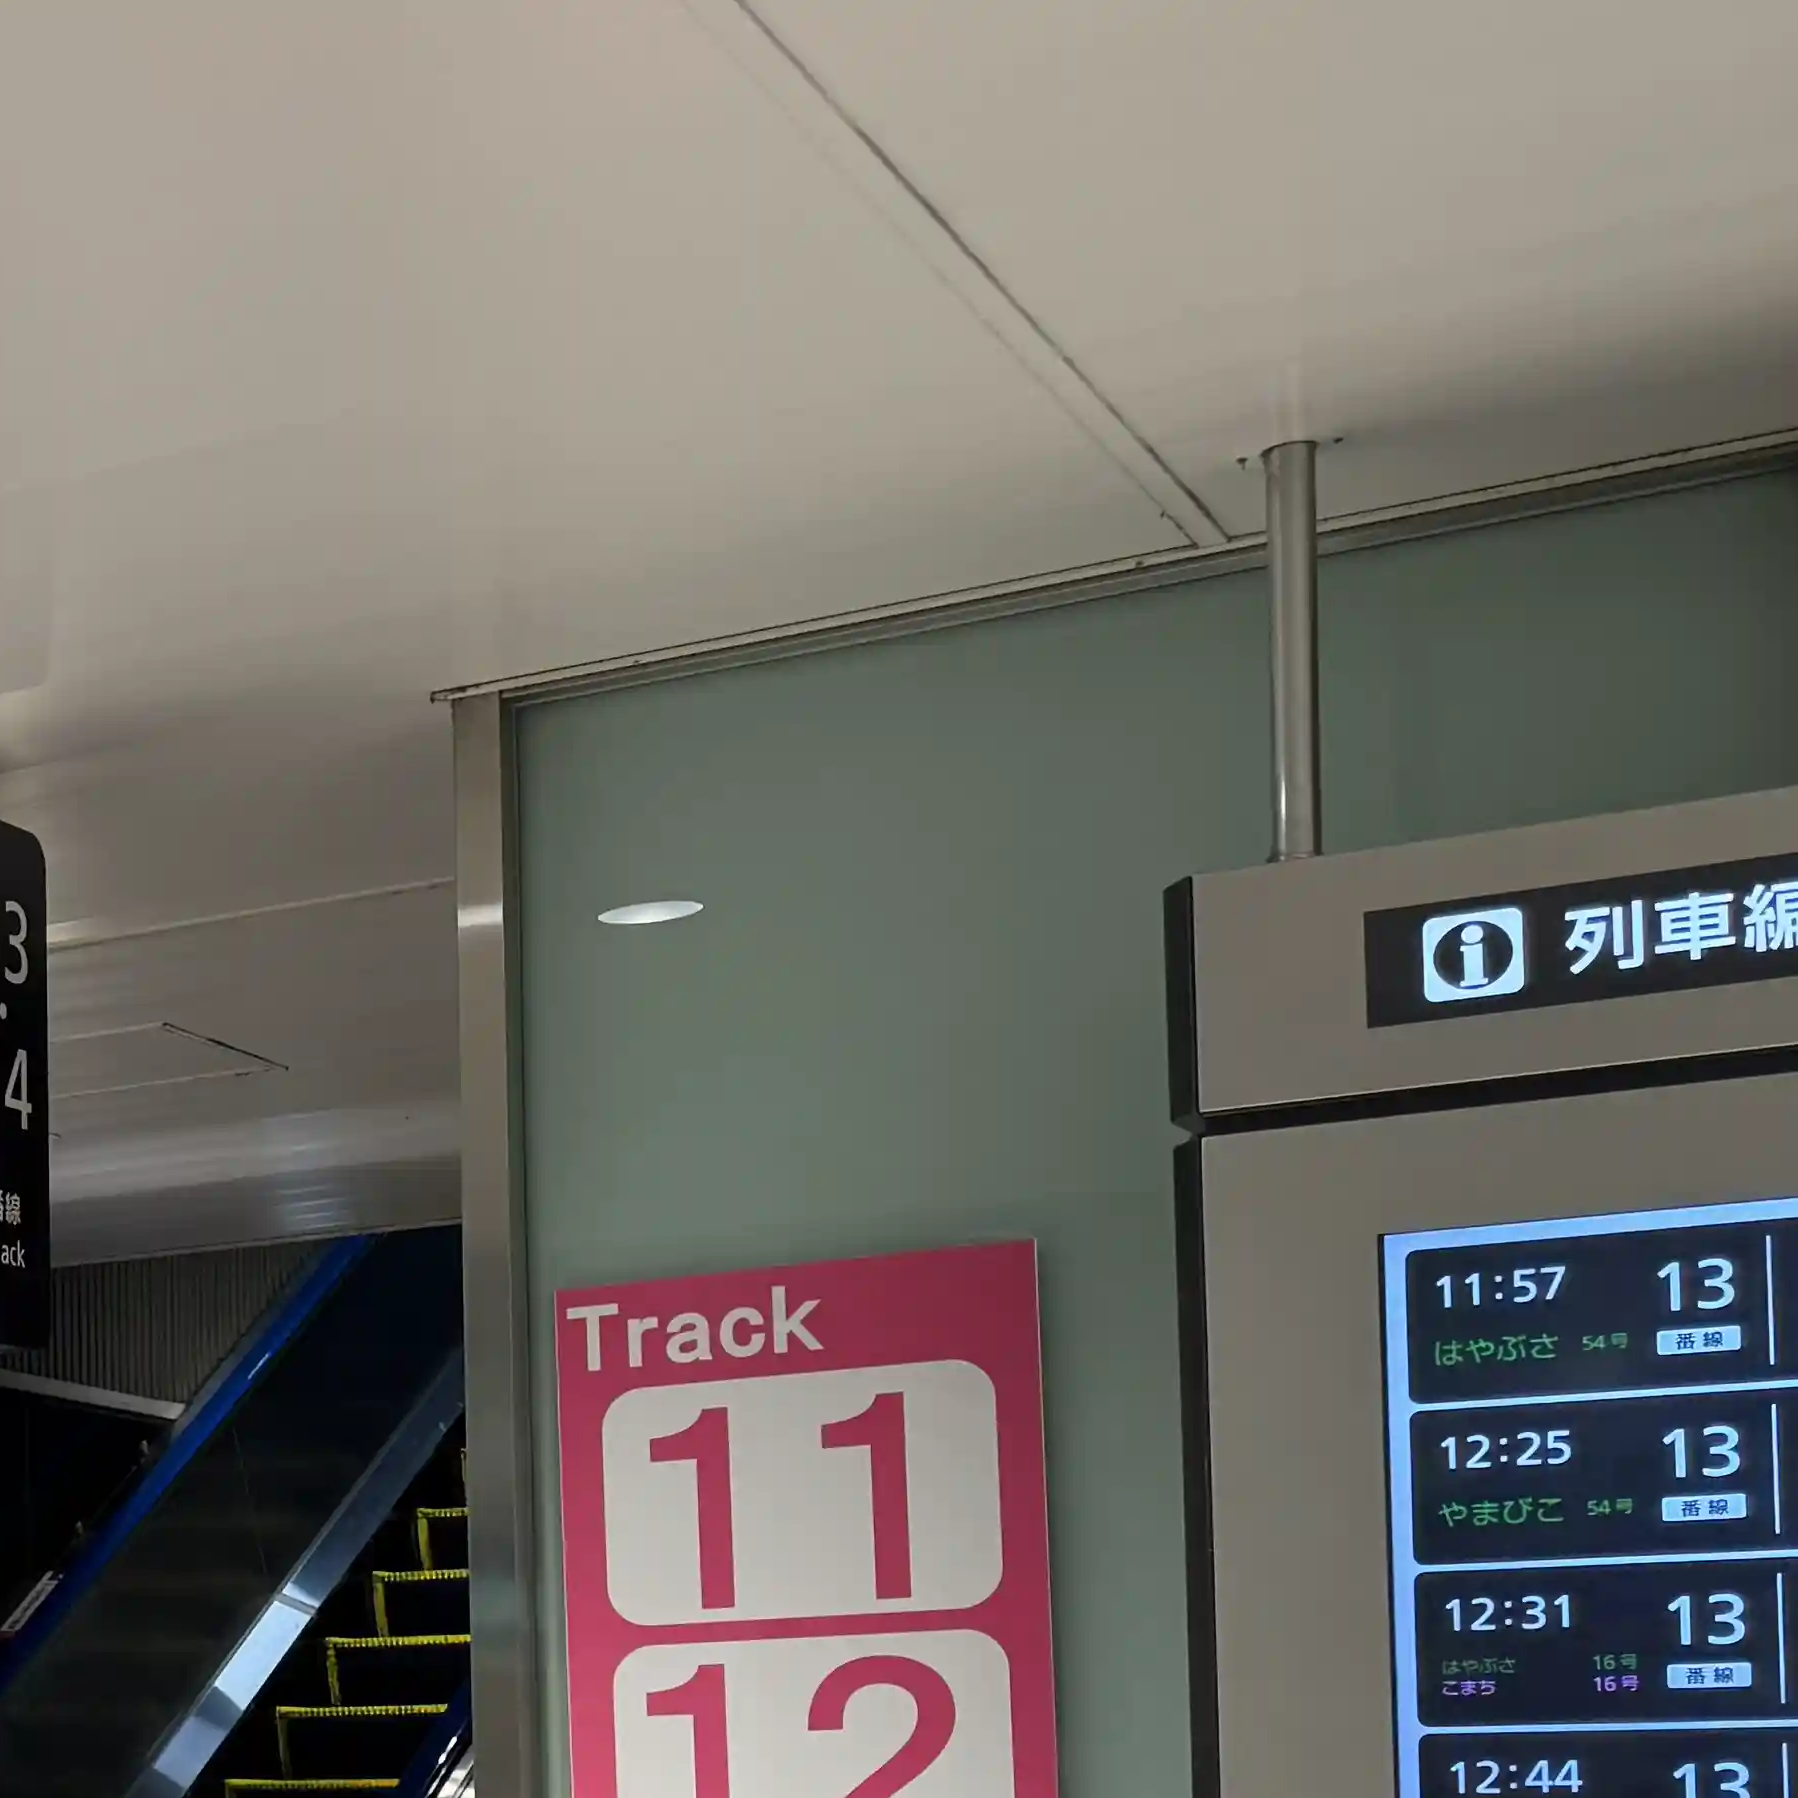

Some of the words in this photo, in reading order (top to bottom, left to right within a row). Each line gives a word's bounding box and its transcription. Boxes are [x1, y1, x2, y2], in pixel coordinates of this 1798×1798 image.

[1436, 1265, 1566, 1308] 11:57
[1657, 1258, 1735, 1312] 13
[567, 1286, 824, 1371] Track
[1434, 1335, 1558, 1365] はやぶさ
[1582, 1332, 1628, 1350] 54号
[1675, 1332, 1723, 1350] 番線
[1441, 1430, 1572, 1470] 12:25
[1662, 1425, 1741, 1478] 13
[648, 1391, 912, 1609] 11
[1438, 1498, 1564, 1527] やまびこ
[1587, 1498, 1633, 1515] 54号
[1682, 1500, 1728, 1516] 番線
[1445, 1595, 1571, 1632] 12:31
[1668, 1594, 1745, 1646] 13
[1442, 1658, 1516, 1674] はやぶさ
[1593, 1654, 1638, 1670] 16号
[1442, 1680, 1496, 1696] こまち
[1593, 1676, 1639, 1692] 16号
[1686, 1667, 1734, 1685] 番線
[1450, 1760, 1583, 1794] 12:44
